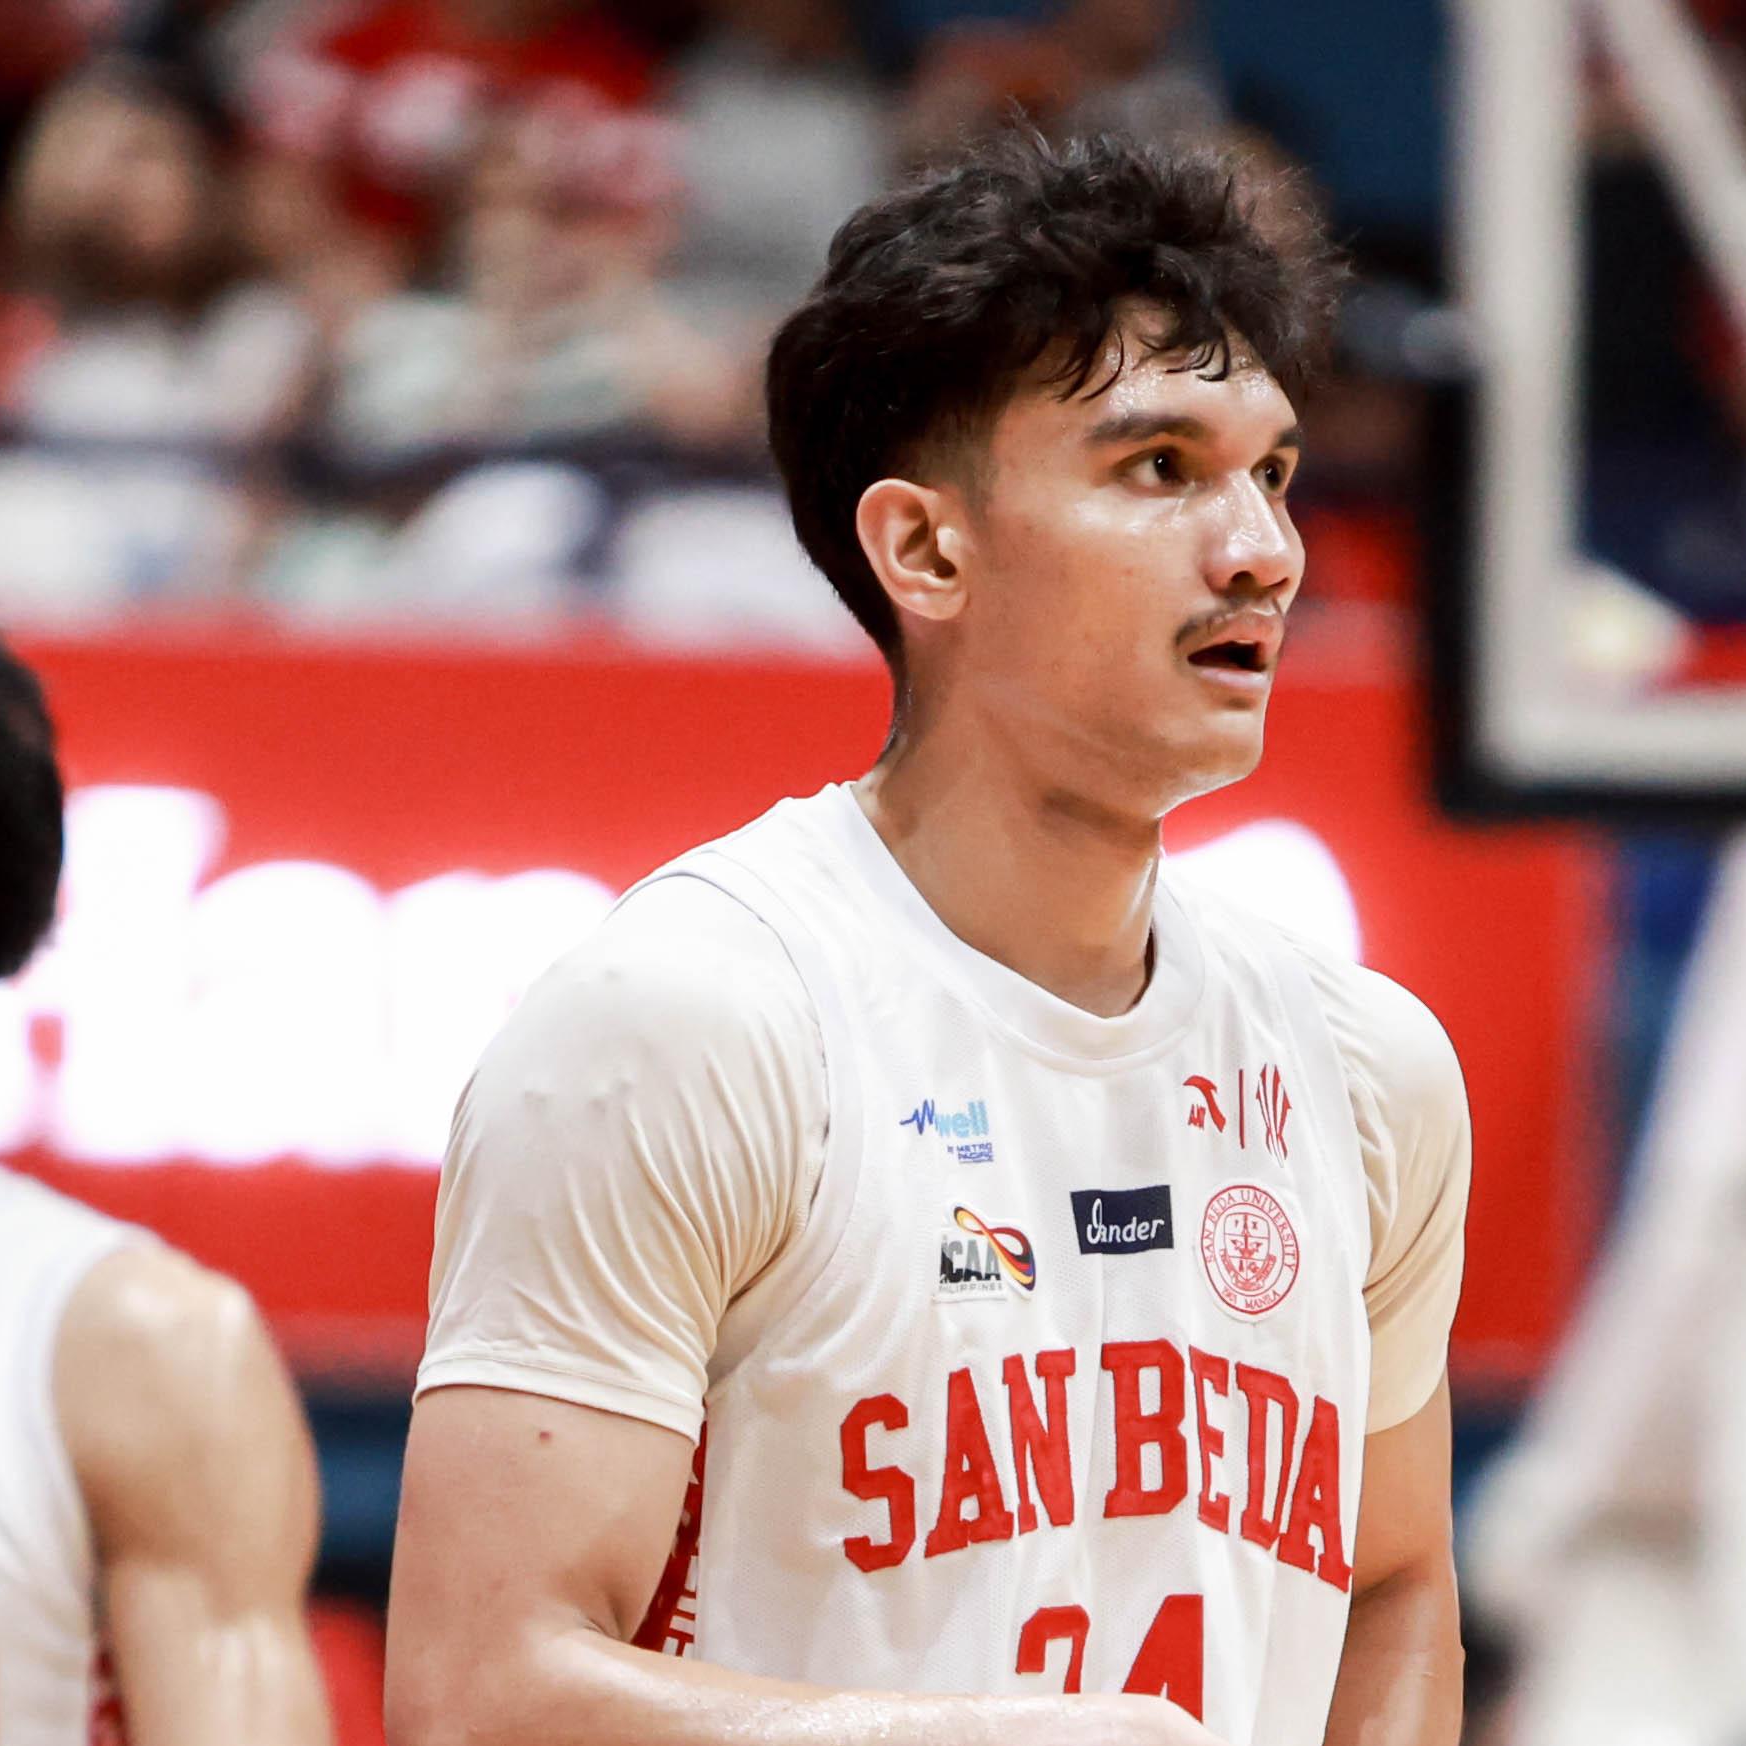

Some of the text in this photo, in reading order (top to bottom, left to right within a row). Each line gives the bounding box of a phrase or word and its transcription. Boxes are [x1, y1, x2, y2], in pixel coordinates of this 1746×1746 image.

[1240, 1190, 1296, 1272] UNIVERSITY
[839, 1336, 1352, 1594] SAN BEDA
